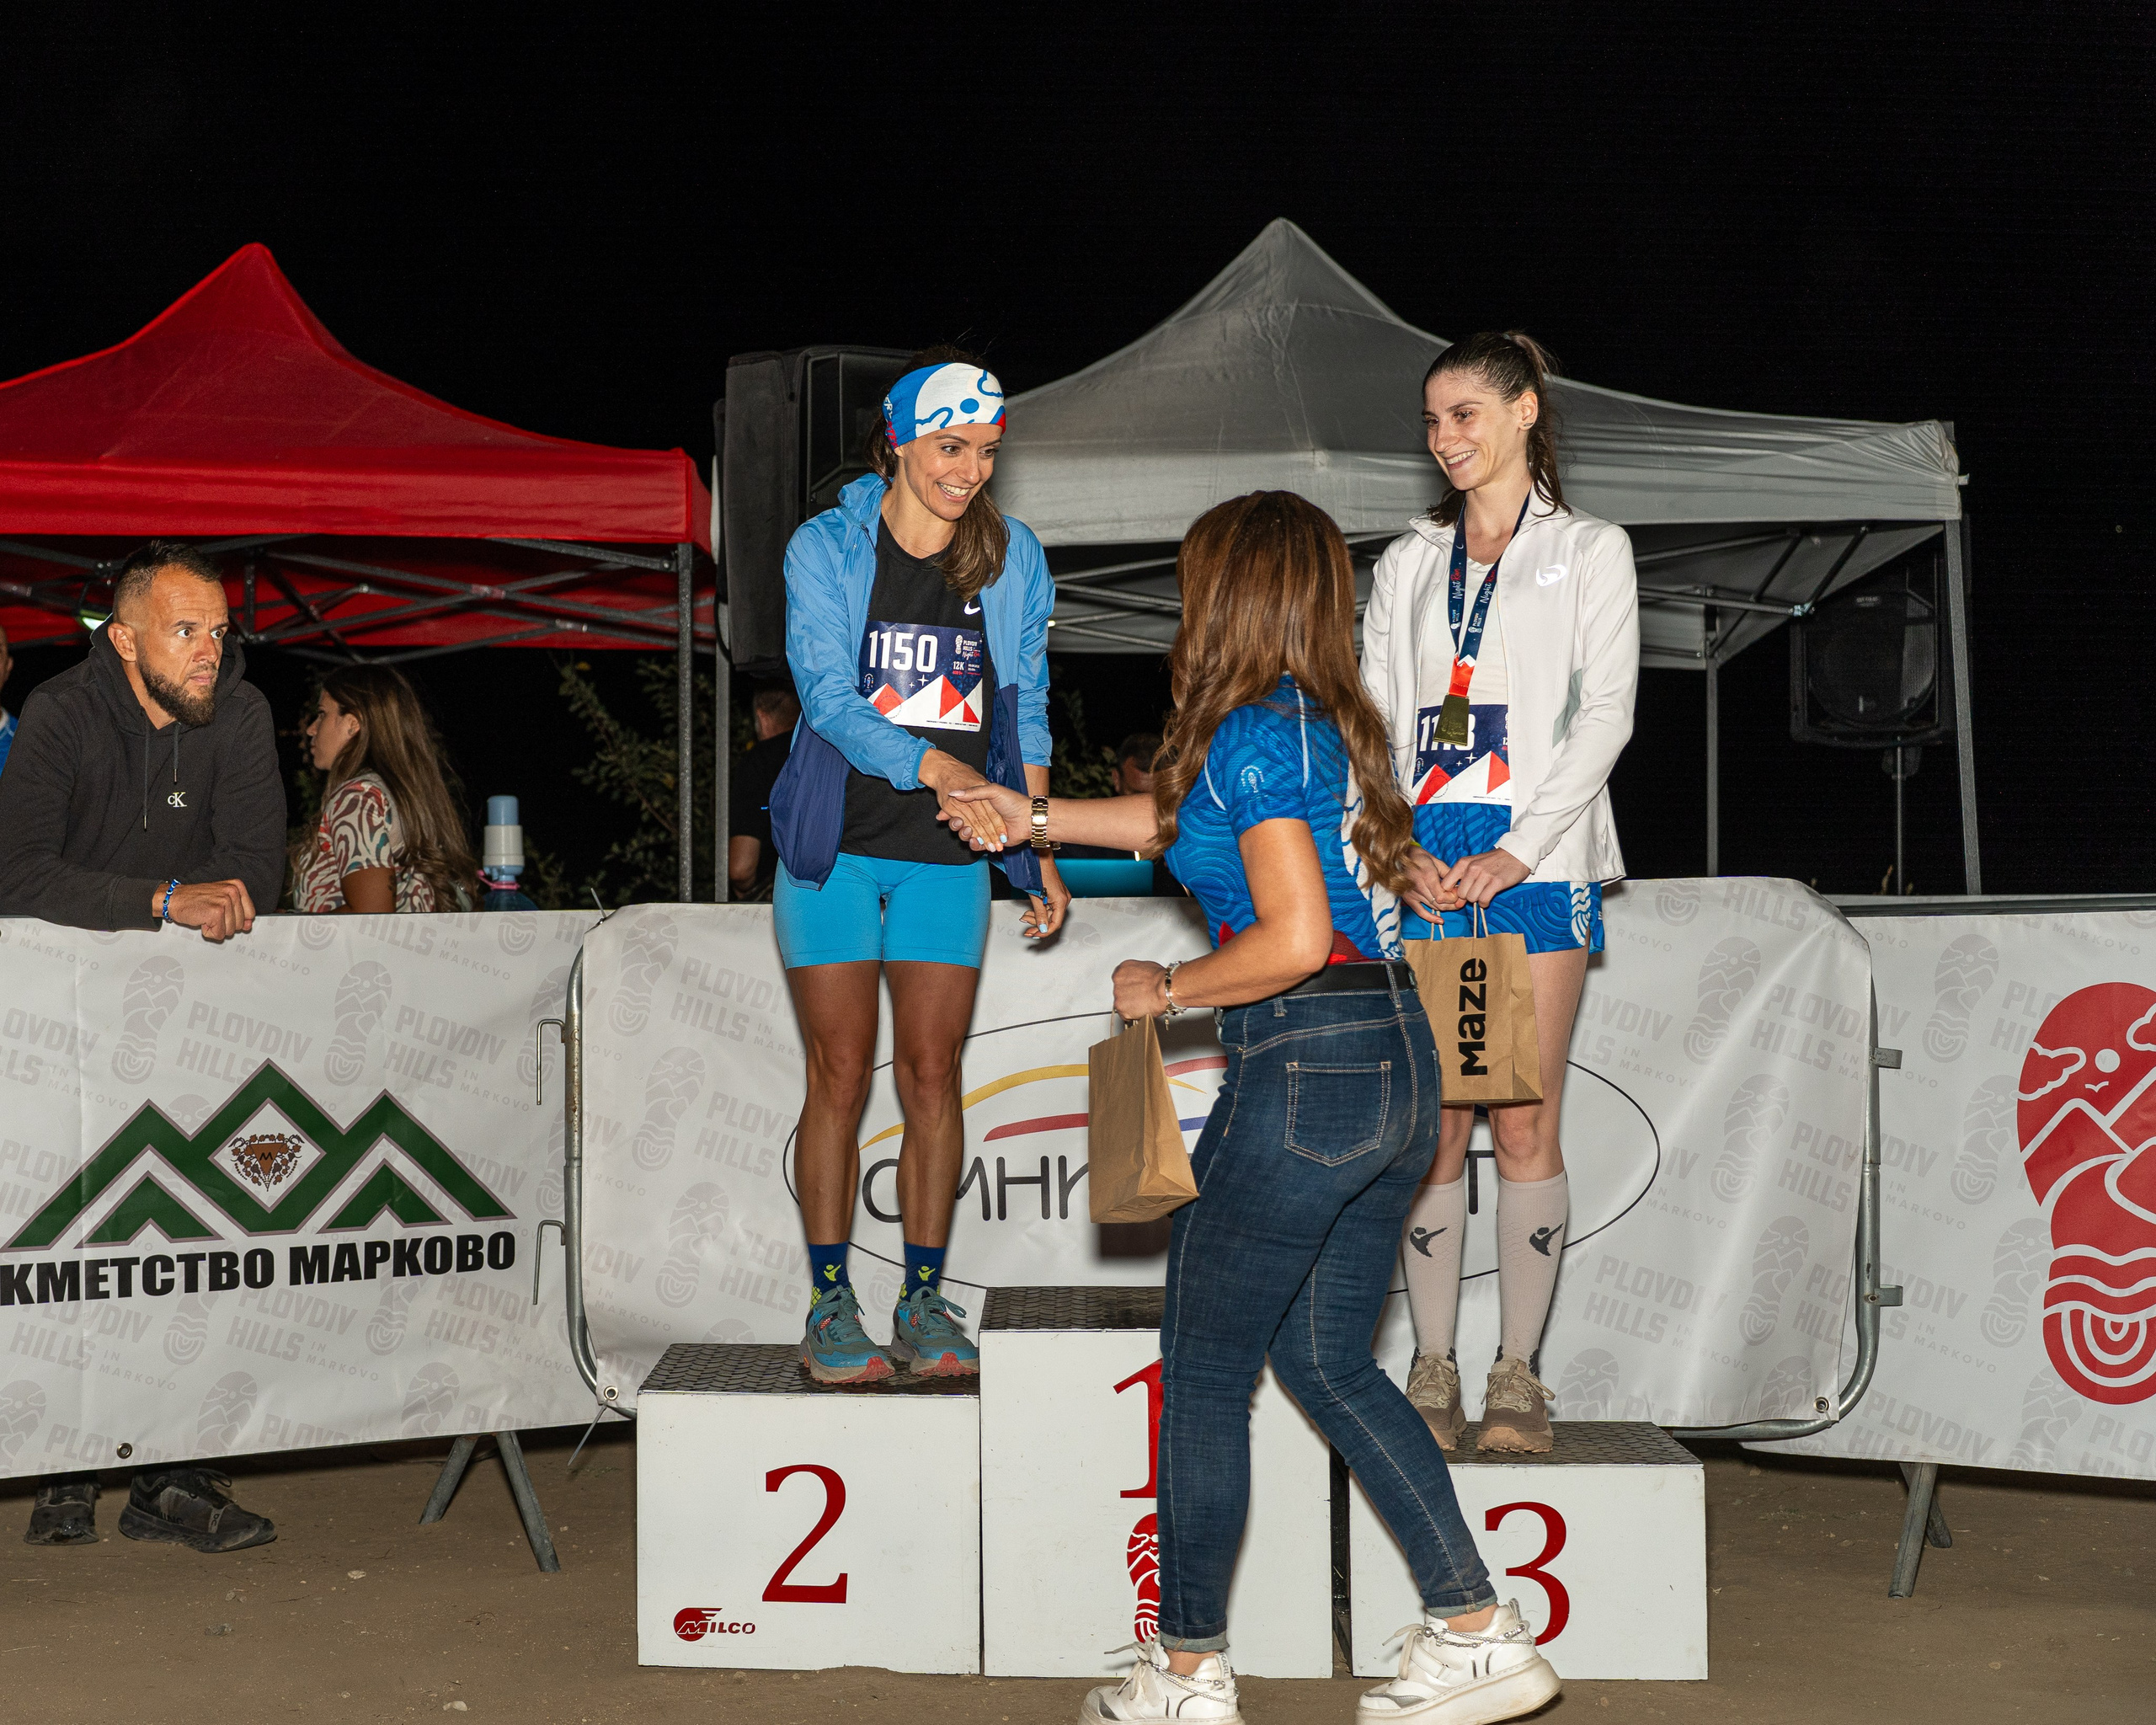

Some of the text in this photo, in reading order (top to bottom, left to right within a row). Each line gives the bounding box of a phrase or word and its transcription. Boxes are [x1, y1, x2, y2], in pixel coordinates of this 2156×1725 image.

[869, 630, 938, 673] 1150
[953, 661, 964, 670] 12K
[19, 937, 100, 971] MARKOVO
[2052, 922, 2141, 956] MARKOVO
[235, 943, 311, 977] MARKOVO
[439, 949, 511, 981] MARKOVO
[187, 1000, 313, 1064] PLOVDIV
[395, 1004, 508, 1066] PLOVDIV
[670, 991, 750, 1043] HILLS
[757, 1023, 773, 1035] IN
[1458, 958, 1488, 1076] Maze
[1623, 1046, 1641, 1059] IN
[1749, 1018, 1836, 1072] HILLS
[1842, 1051, 1860, 1065] IN
[382, 1040, 457, 1090] HILLS
[464, 1069, 479, 1081] IN
[459, 1082, 530, 1112] MARKOVO
[693, 1127, 776, 1178] HILLS
[1778, 1158, 1852, 1213] HILLS
[1889, 1180, 1907, 1194] IN
[1646, 1198, 1727, 1230] MARKOVO
[1884, 1194, 1967, 1231] MARKOVO
[0, 1247, 275, 1306] КМЕТСТВО
[288, 1230, 516, 1287] МАРКОВО
[436, 1272, 547, 1329] PLOVDIV
[718, 1264, 802, 1316] HILLS
[424, 1308, 500, 1356] HILLS
[594, 1300, 672, 1332] MARKOVO
[1582, 1291, 1668, 1345] HILLS
[1918, 1322, 1936, 1335] IN
[9, 1322, 97, 1371] HILLS
[104, 1349, 121, 1362] IN
[226, 1316, 305, 1363] HILLS
[311, 1340, 328, 1354] IN
[1913, 1333, 1999, 1374] MARKOVO
[99, 1364, 177, 1391] MARKOVO
[306, 1354, 379, 1381] MARKOVO
[503, 1346, 573, 1375] MARKOVO
[1113, 1358, 1164, 1498] 1
[1862, 1389, 1996, 1464] PLOVDIV
[761, 1464, 848, 1604] 2
[1485, 1501, 1570, 1647] 3
[677, 1621, 756, 1635] MILCO
[1219, 1653, 1230, 1677] KARL
